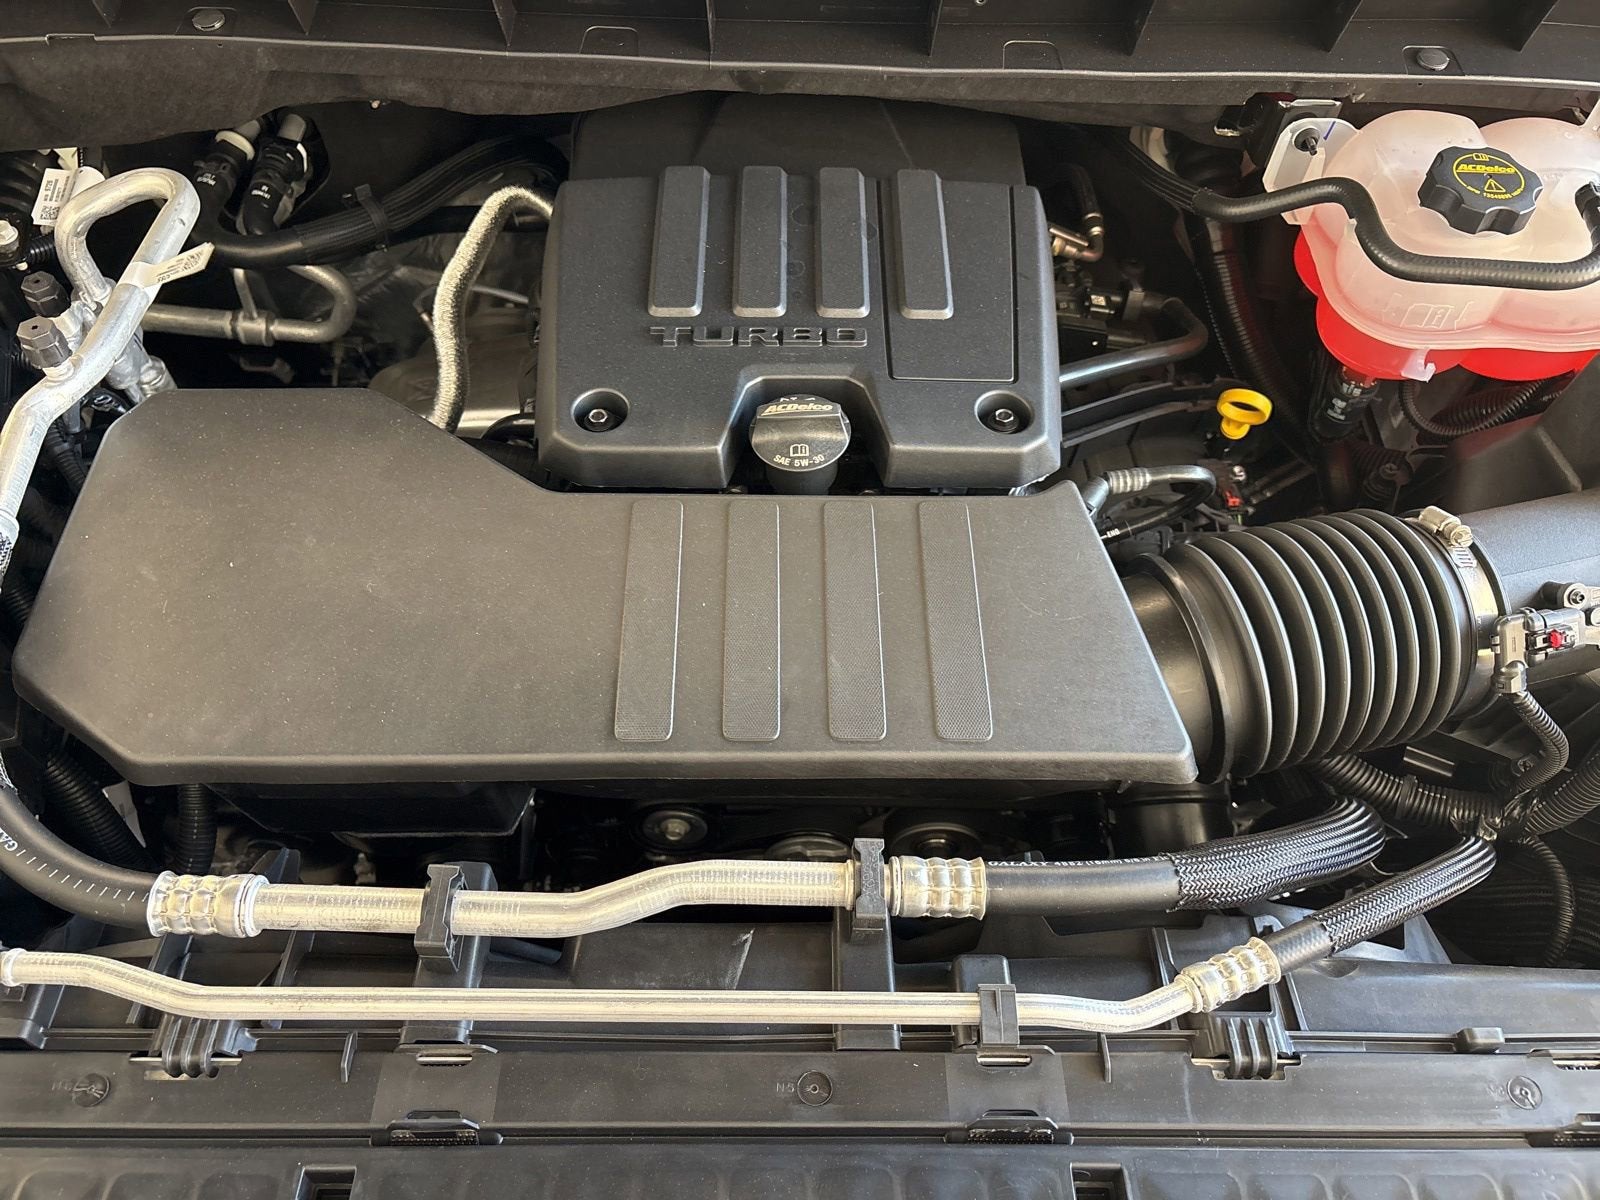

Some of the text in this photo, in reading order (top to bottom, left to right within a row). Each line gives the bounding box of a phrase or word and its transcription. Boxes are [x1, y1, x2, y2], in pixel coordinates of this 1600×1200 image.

[1457, 163, 1516, 174] ACDelco
[650, 326, 867, 347] TURBO
[761, 403, 833, 415] ACDelco
[773, 454, 825, 467] SAE 5W-30
